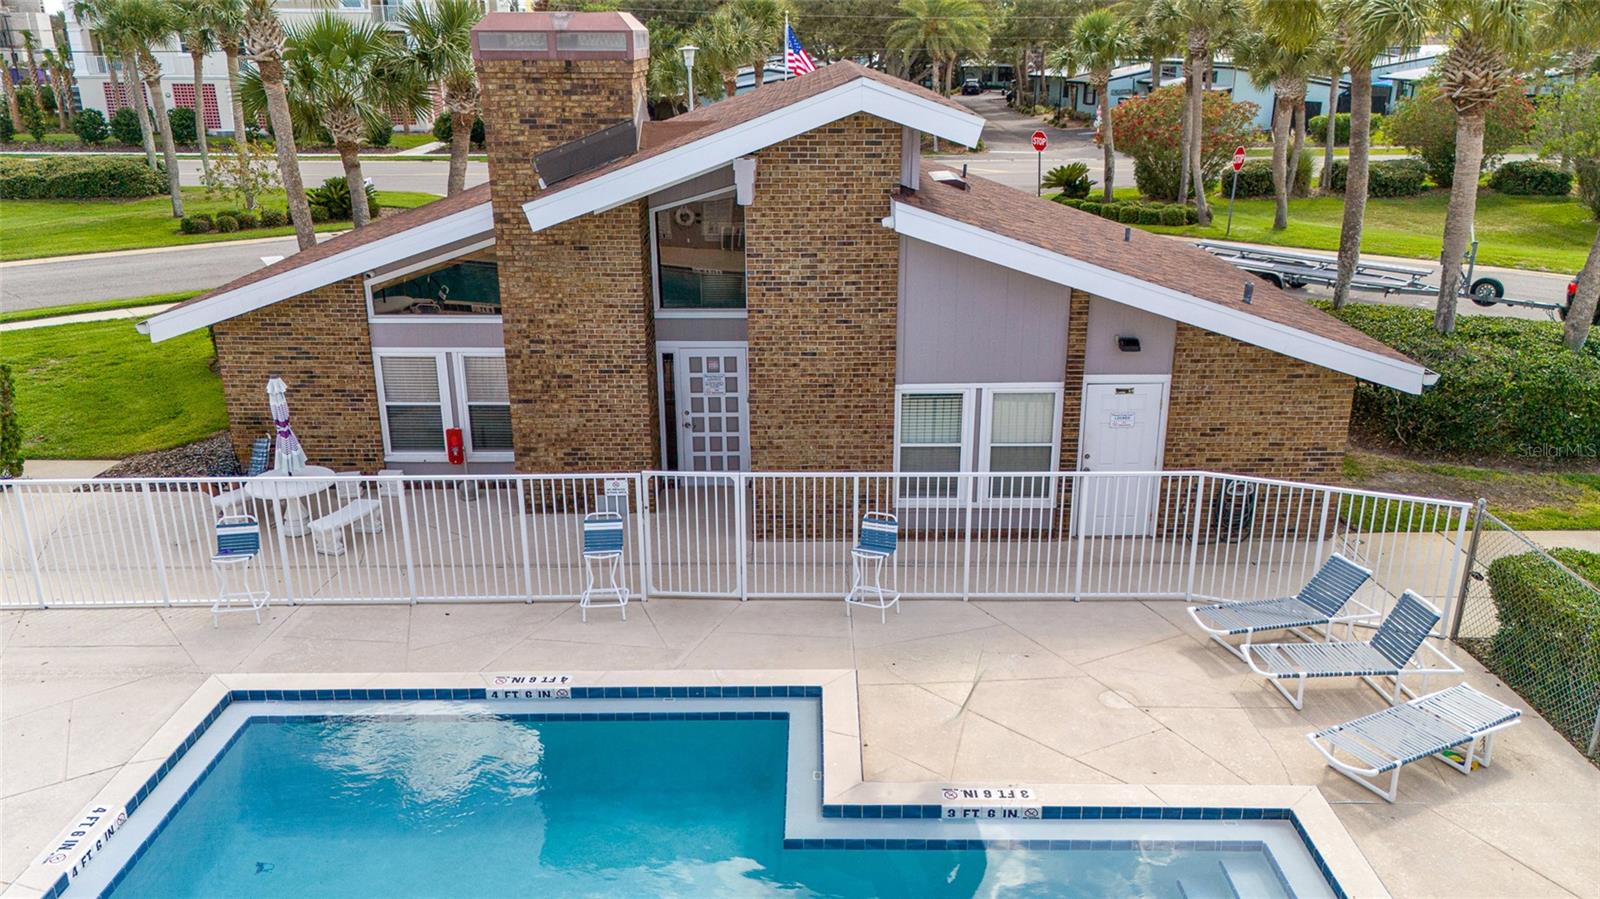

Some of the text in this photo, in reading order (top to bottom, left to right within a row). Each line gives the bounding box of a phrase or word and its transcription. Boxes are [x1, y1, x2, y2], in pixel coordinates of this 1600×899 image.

[1033, 137, 1046, 145] STOP
[561, 676, 568, 684] 4
[983, 789, 992, 799] 6
[1020, 789, 1029, 799] 3
[947, 808, 956, 818] 3
[987, 808, 996, 818] 6
[72, 866, 78, 878] 4
